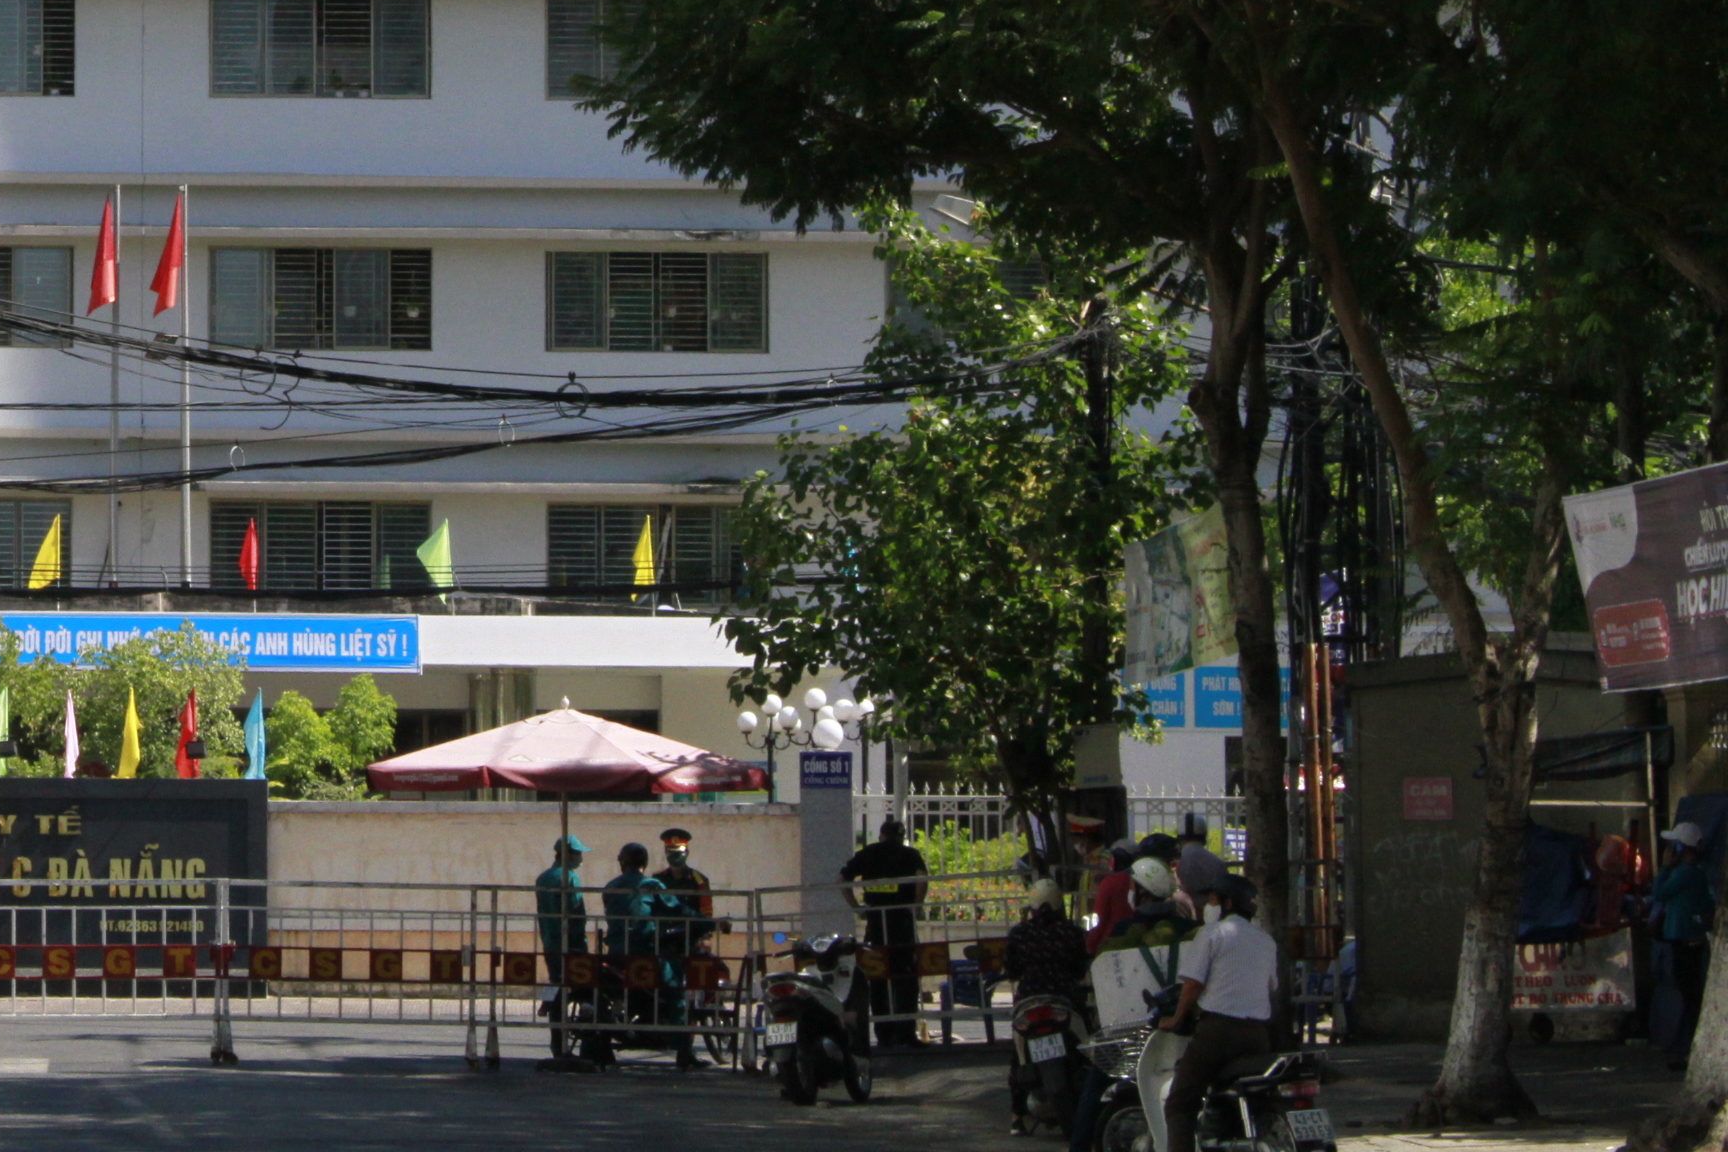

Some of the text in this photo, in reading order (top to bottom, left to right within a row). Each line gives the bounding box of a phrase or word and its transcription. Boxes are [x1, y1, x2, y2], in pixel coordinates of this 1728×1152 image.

[1677, 576, 1709, 626] HỌC
[45, 625, 71, 654] ĐỜI
[255, 632, 289, 656] ANH
[293, 627, 337, 656] HÙNG
[340, 628, 372, 662] LIỆT
[376, 628, 397, 657] SỸ
[1202, 674, 1227, 691] PHÁT
[34, 805, 82, 835] TẾ
[13, 856, 32, 898] C
[47, 849, 94, 898] ĐÀ
[109, 843, 206, 900] NẴNG
